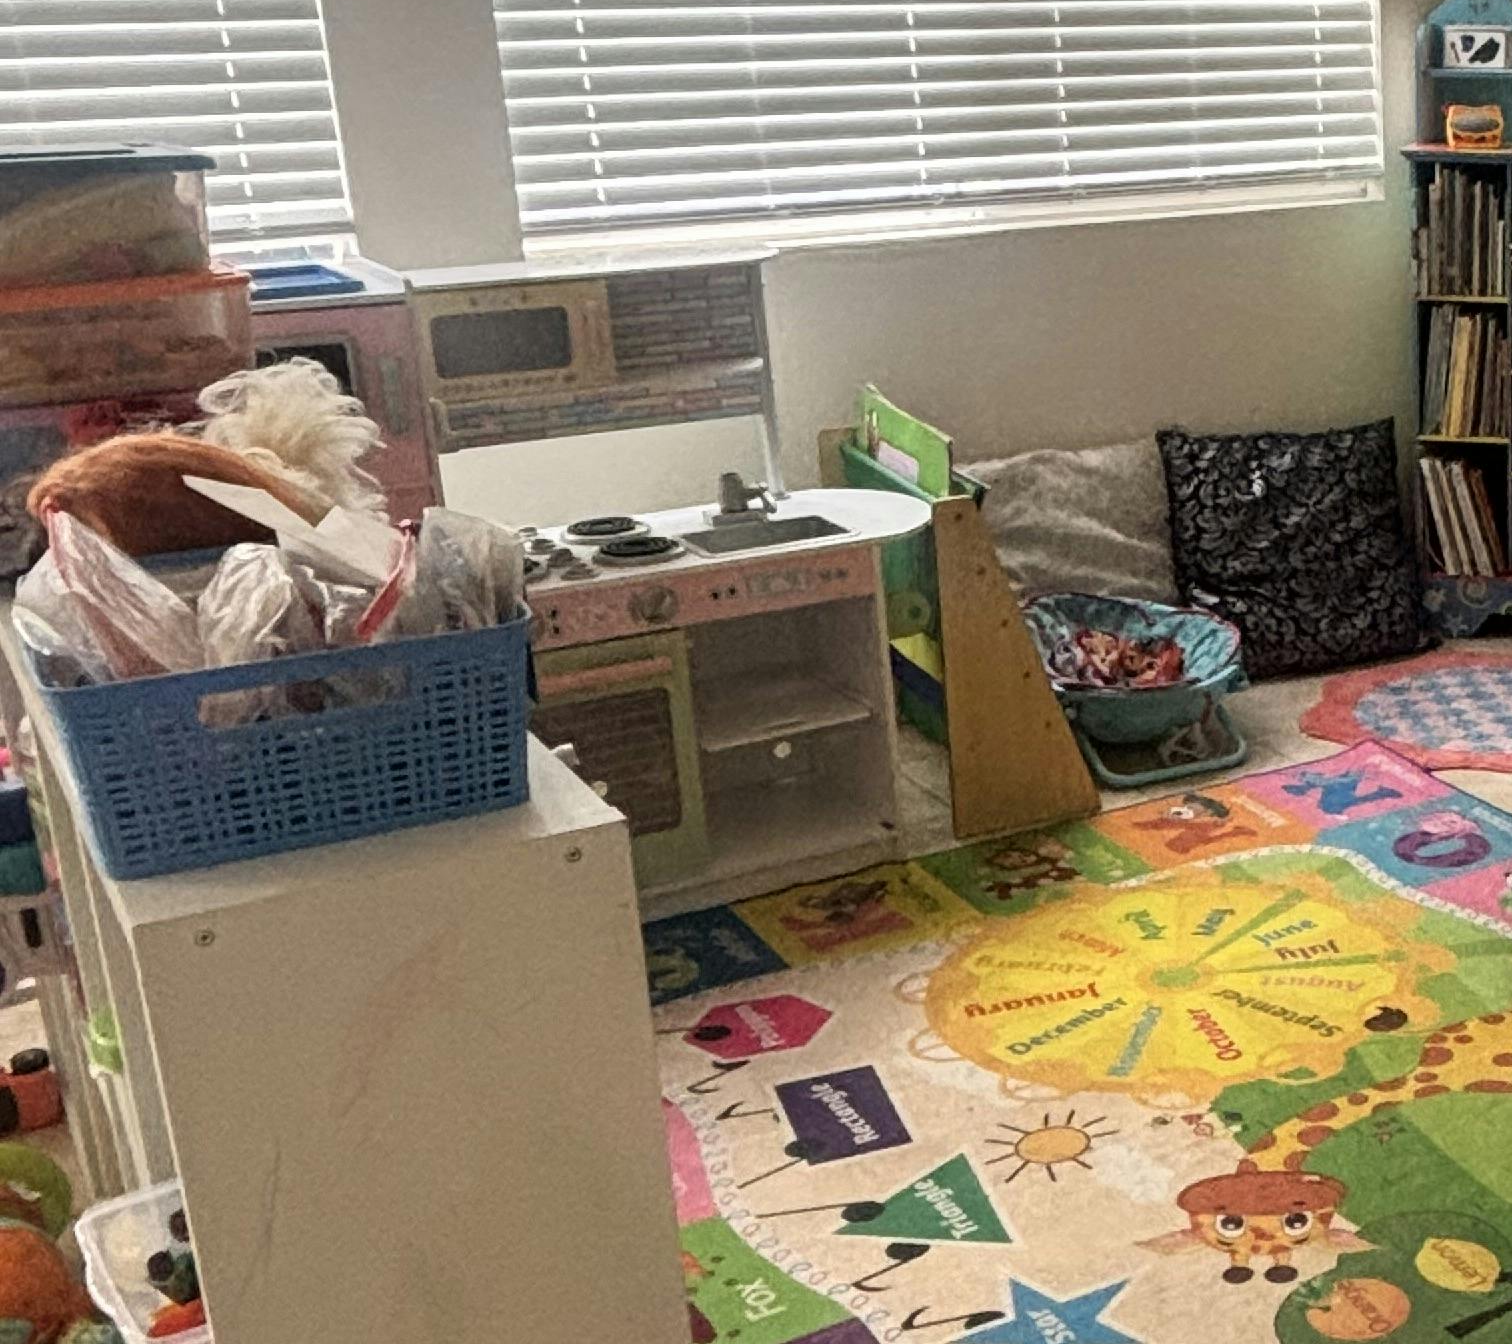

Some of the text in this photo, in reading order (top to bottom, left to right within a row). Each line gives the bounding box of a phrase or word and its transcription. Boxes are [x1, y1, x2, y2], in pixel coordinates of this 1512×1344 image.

[1057, 928, 1127, 959] March
[1251, 918, 1318, 947] June
[1274, 939, 1341, 962] July
[973, 955, 1108, 977] February
[1260, 975, 1366, 994] August
[963, 981, 1101, 1019] January
[1211, 988, 1344, 1038] September
[1005, 996, 1128, 1056] December
[1187, 1007, 1243, 1062] October
[811, 1080, 881, 1146] Rectangle
[914, 1178, 979, 1240] Triangle
[1430, 1237, 1488, 1288] Lemon
[736, 1278, 787, 1323] Fox
[1337, 1281, 1393, 1334] Orange
